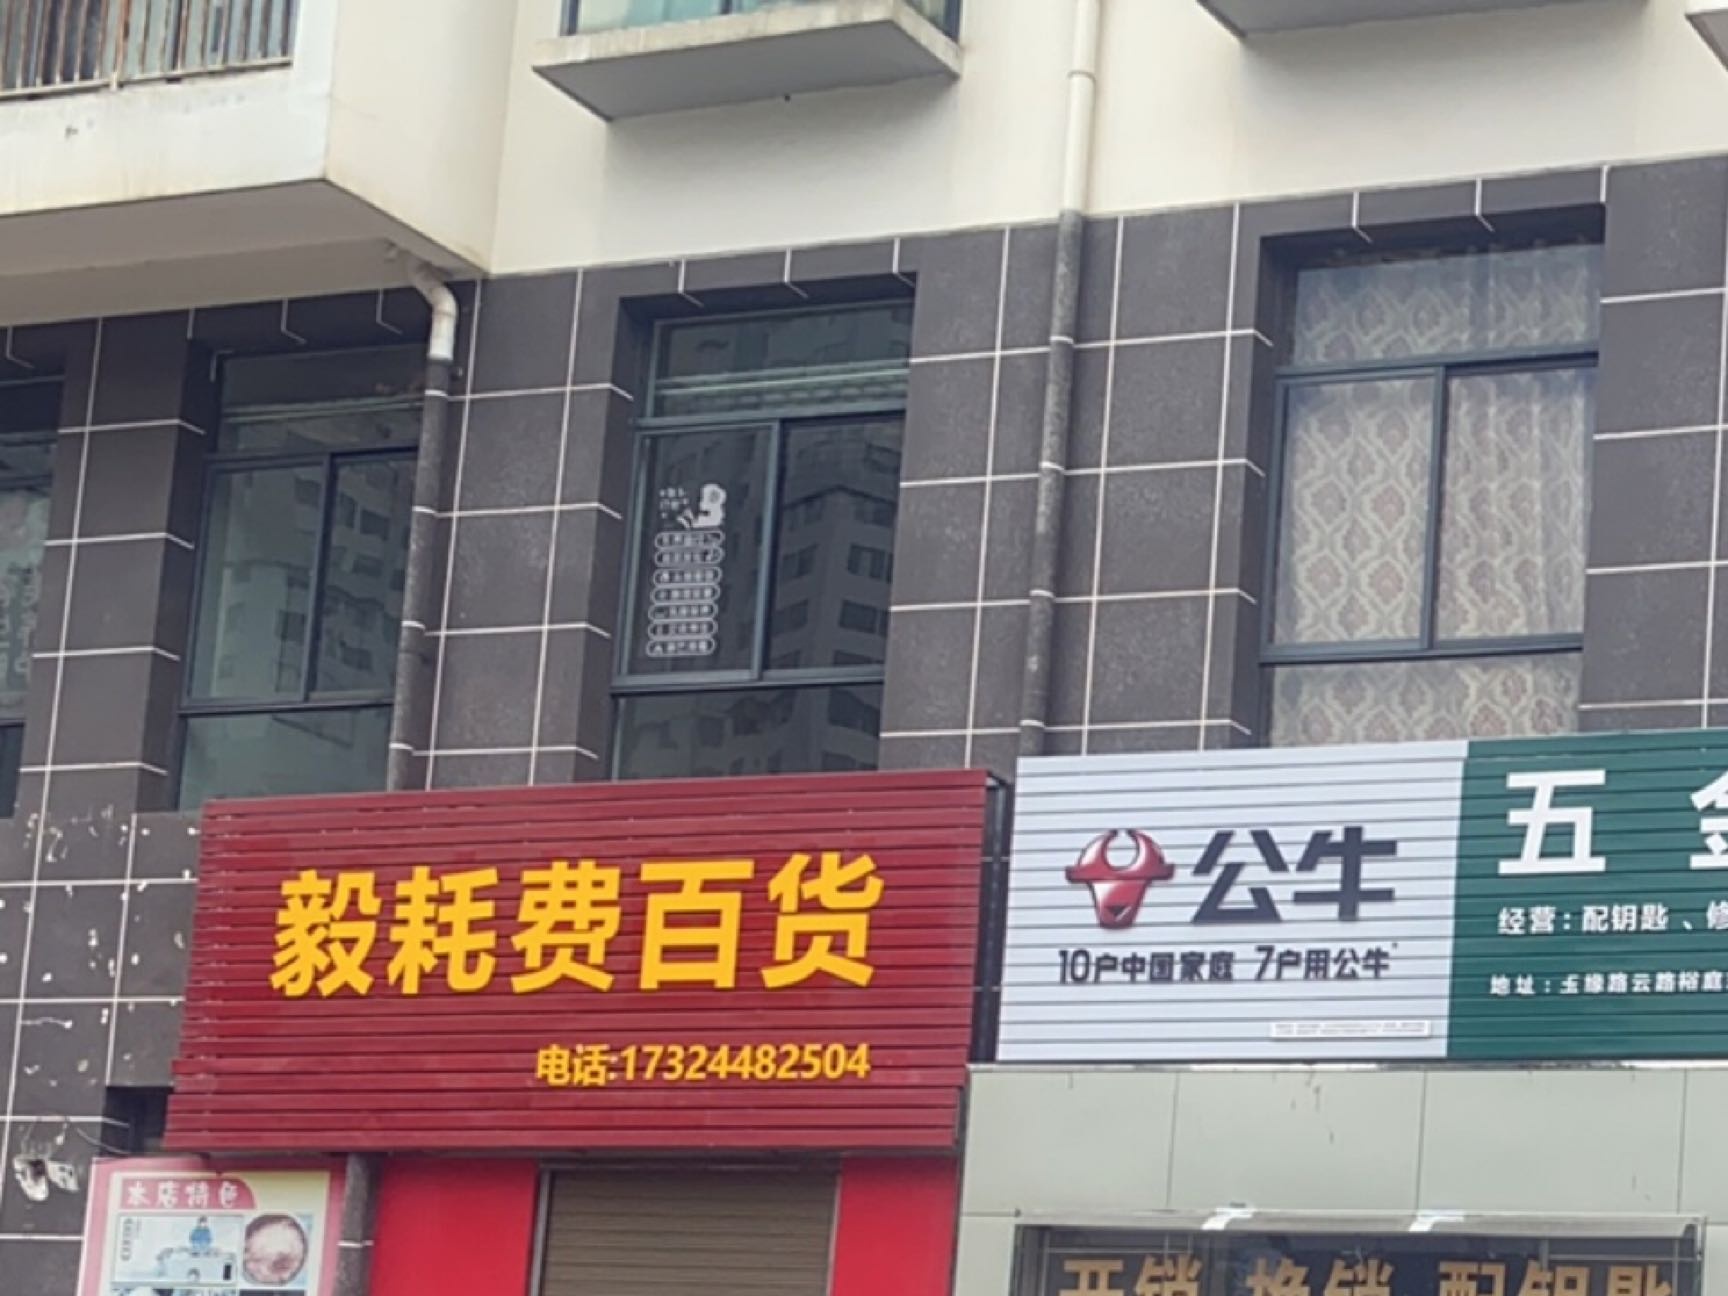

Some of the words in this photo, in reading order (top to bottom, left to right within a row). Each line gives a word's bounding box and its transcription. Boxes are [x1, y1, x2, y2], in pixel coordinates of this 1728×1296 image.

[1191, 826, 1398, 924] 公牛
[269, 851, 885, 998] 毅耗费百货
[1058, 948, 1236, 985] 10户中国家庭
[1255, 944, 1391, 981] 7户用公牛
[535, 1043, 872, 1086] 电话:17324482504
[126, 1180, 238, 1208] 本店特色
